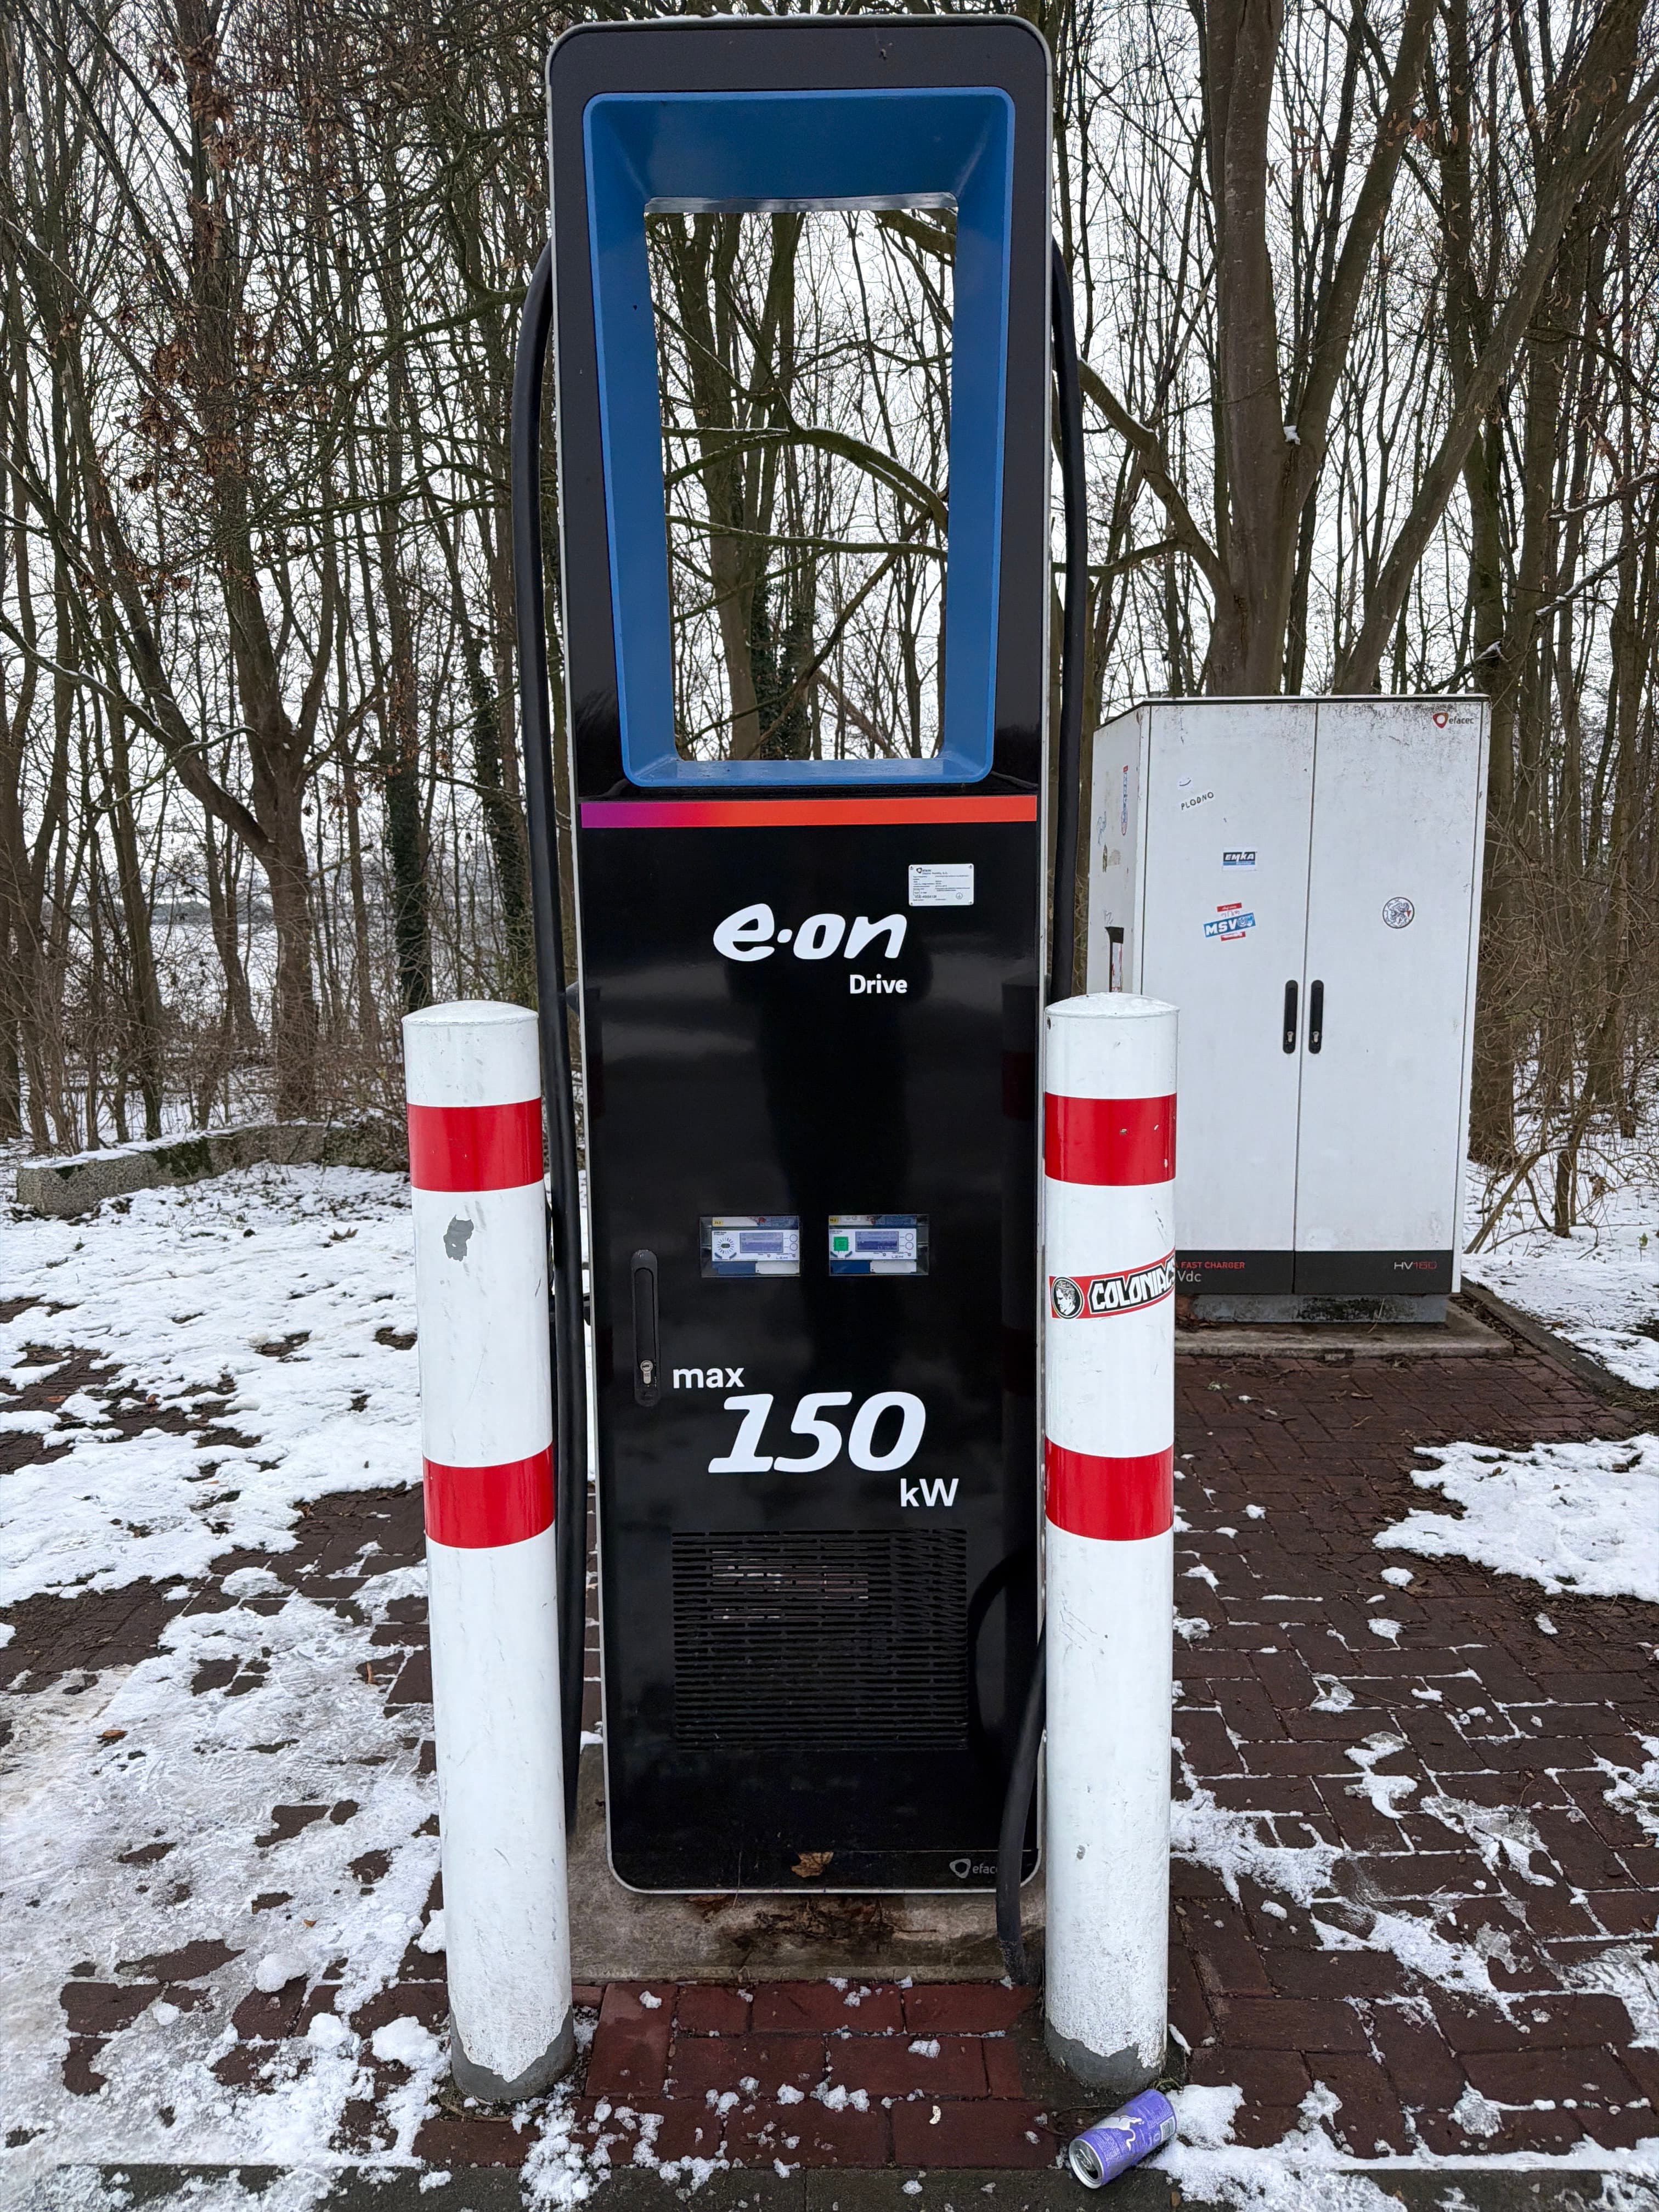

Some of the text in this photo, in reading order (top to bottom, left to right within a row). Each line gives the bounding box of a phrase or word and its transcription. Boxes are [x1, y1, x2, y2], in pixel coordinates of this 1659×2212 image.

[1449, 715, 1475, 724] efacec
[1181, 792, 1214, 810] PLODNO
[1225, 851, 1254, 862] EMKA
[1205, 918, 1238, 935] MSV
[849, 973, 908, 994] Drive
[673, 1367, 744, 1389] max
[708, 1391, 926, 1474] 150
[900, 1478, 959, 1508] kW
